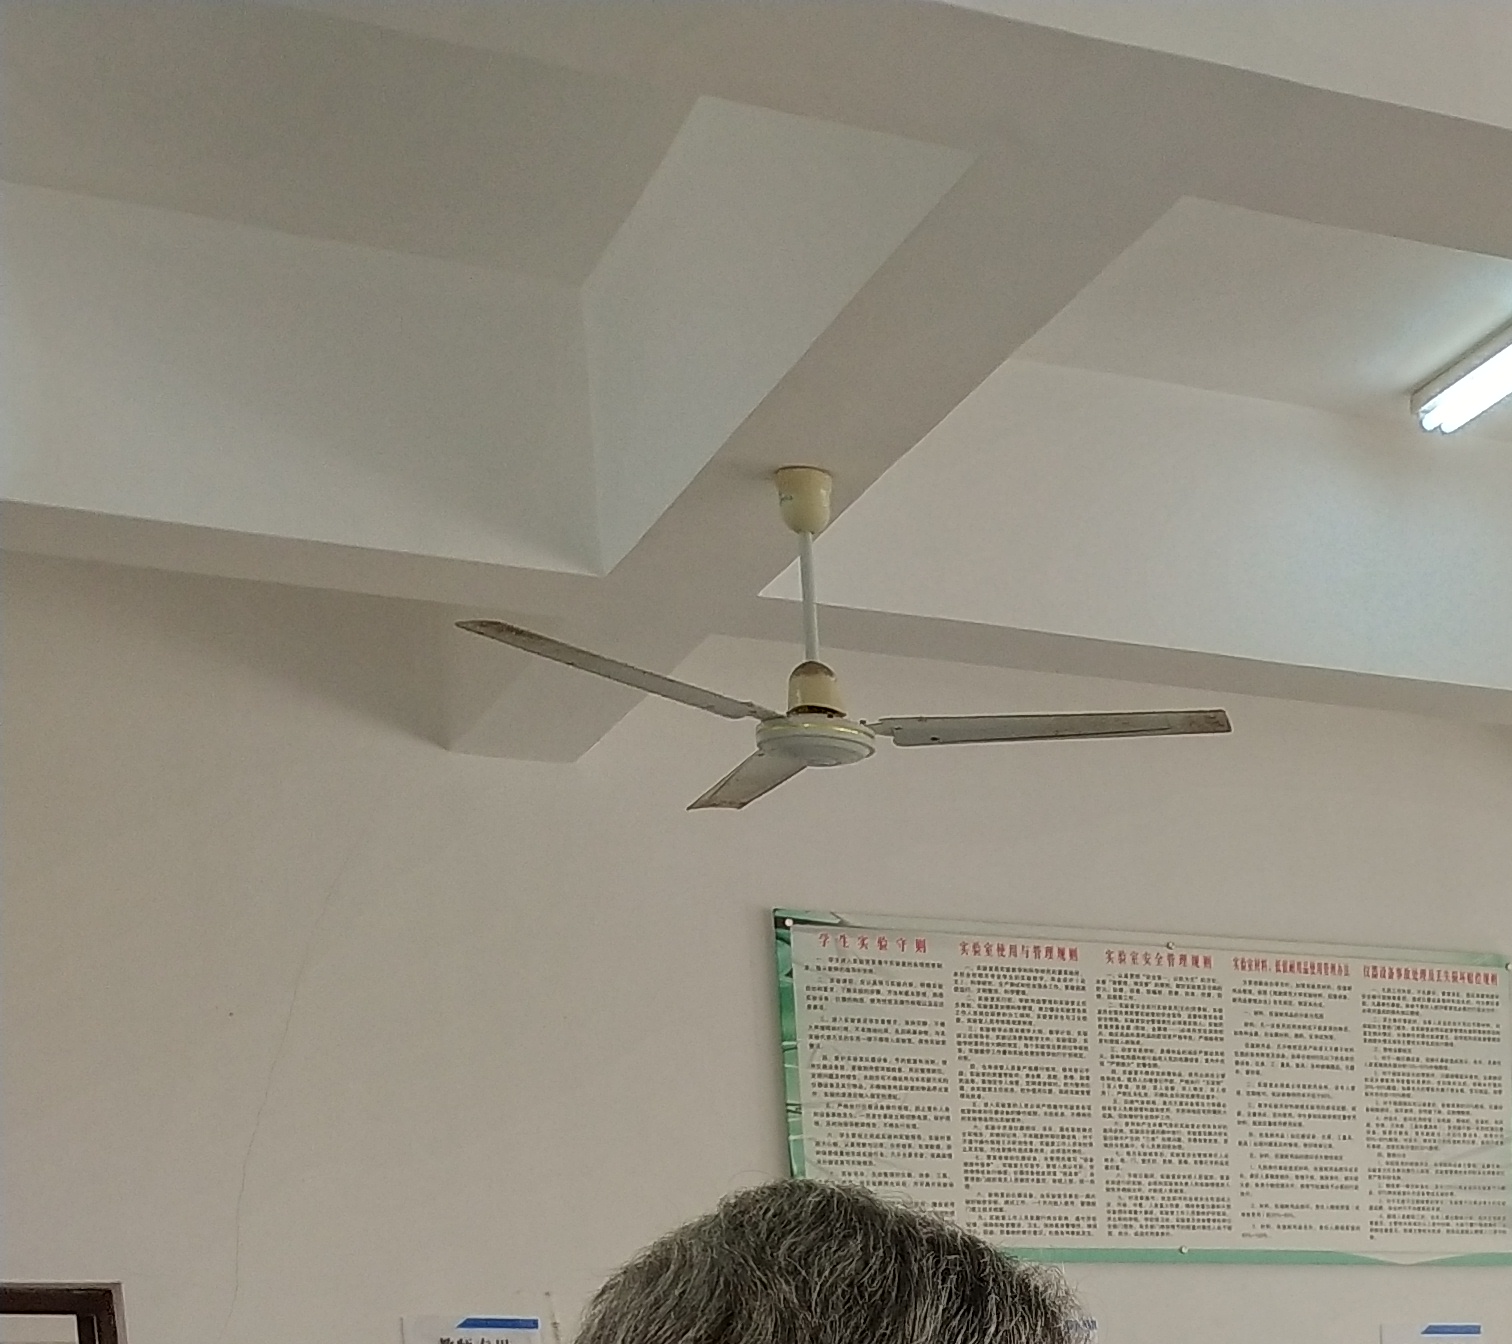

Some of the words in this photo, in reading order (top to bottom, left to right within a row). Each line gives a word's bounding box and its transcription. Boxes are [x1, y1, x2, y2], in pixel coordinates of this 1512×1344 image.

[818, 933, 927, 953] 学生实验守则
[959, 941, 1079, 963] 实验室使用与管理规则
